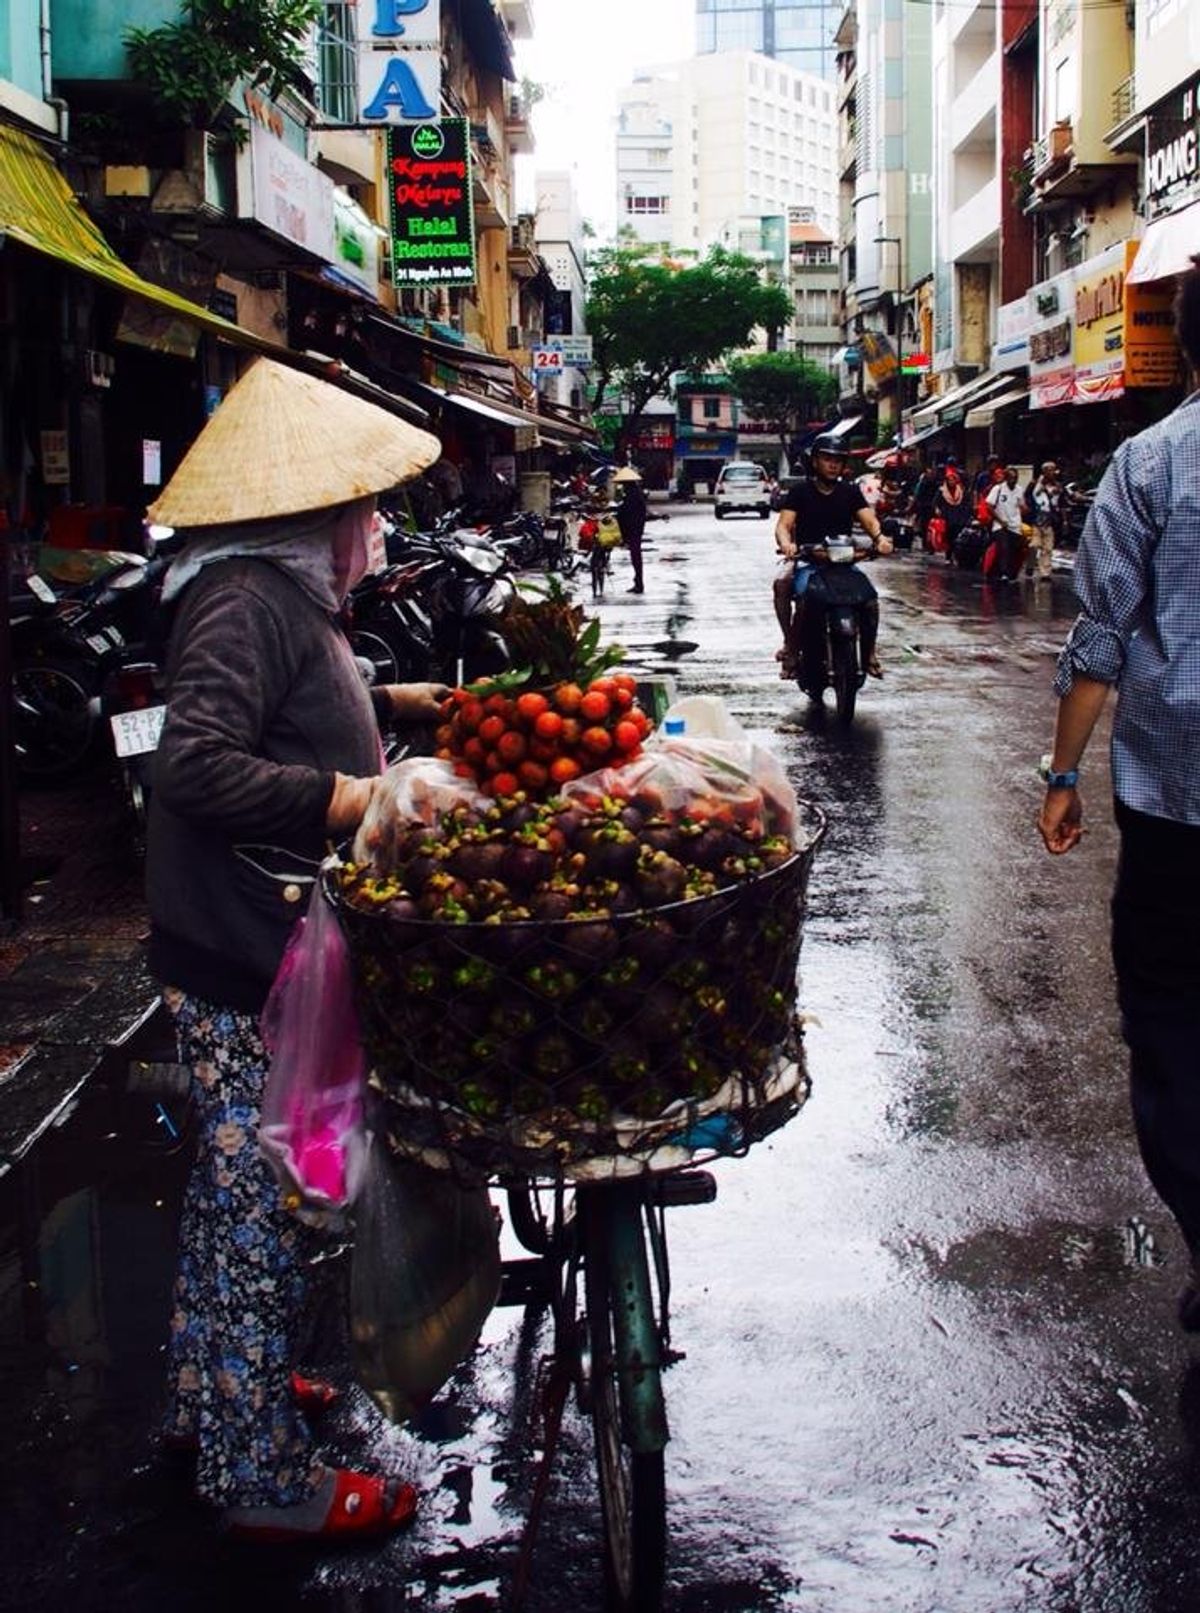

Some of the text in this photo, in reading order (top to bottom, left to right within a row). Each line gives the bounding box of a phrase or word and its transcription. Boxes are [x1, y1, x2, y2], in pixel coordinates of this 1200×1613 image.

[408, 217, 457, 235] Halal
[397, 241, 469, 258] Restoran
[537, 352, 560, 367] 24
